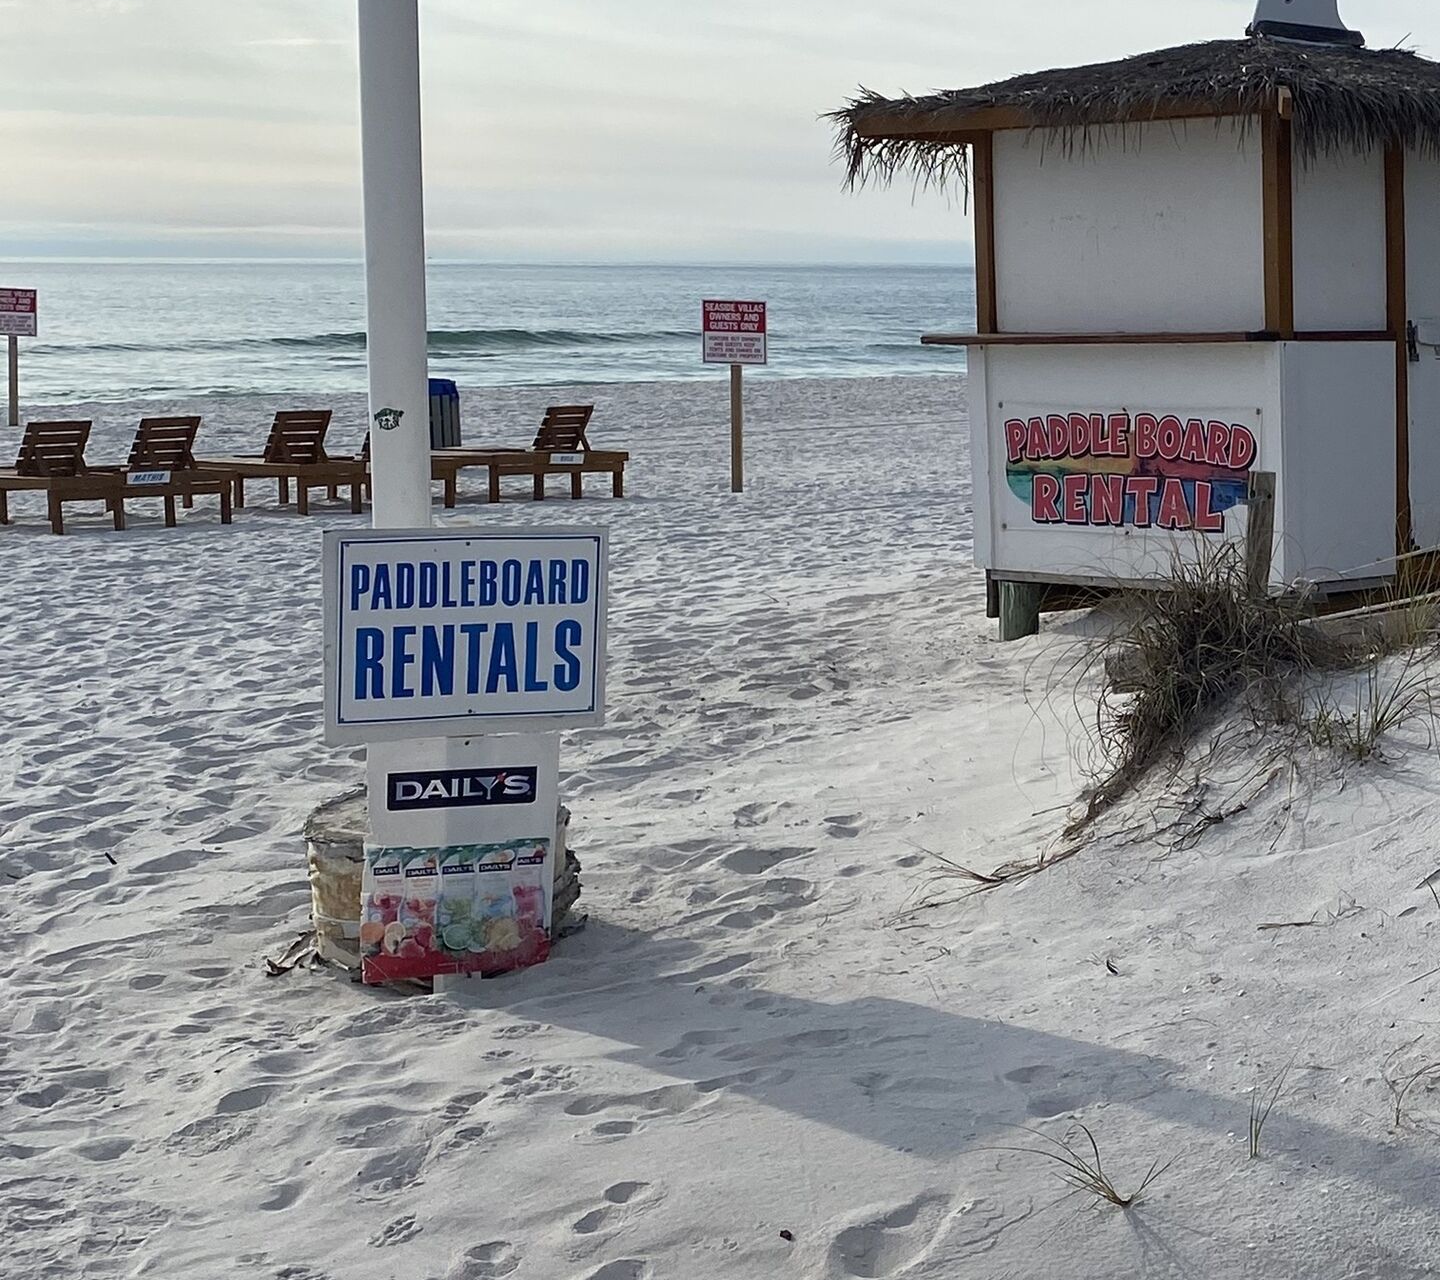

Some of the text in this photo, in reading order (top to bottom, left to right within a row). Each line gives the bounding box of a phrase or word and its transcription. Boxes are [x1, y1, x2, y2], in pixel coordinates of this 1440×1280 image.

[704, 303, 764, 312] SEASIDE VILLAS
[709, 312, 759, 322] OWNERS AND
[709, 322, 759, 330] GUESTS ONLY
[1005, 413, 1257, 470] PADDLE BOARD
[1032, 473, 1225, 533] RENTAL
[351, 559, 589, 610] PADDLEBOARD
[354, 620, 582, 700] RENTALS
[395, 772, 531, 801] DAILY'S
